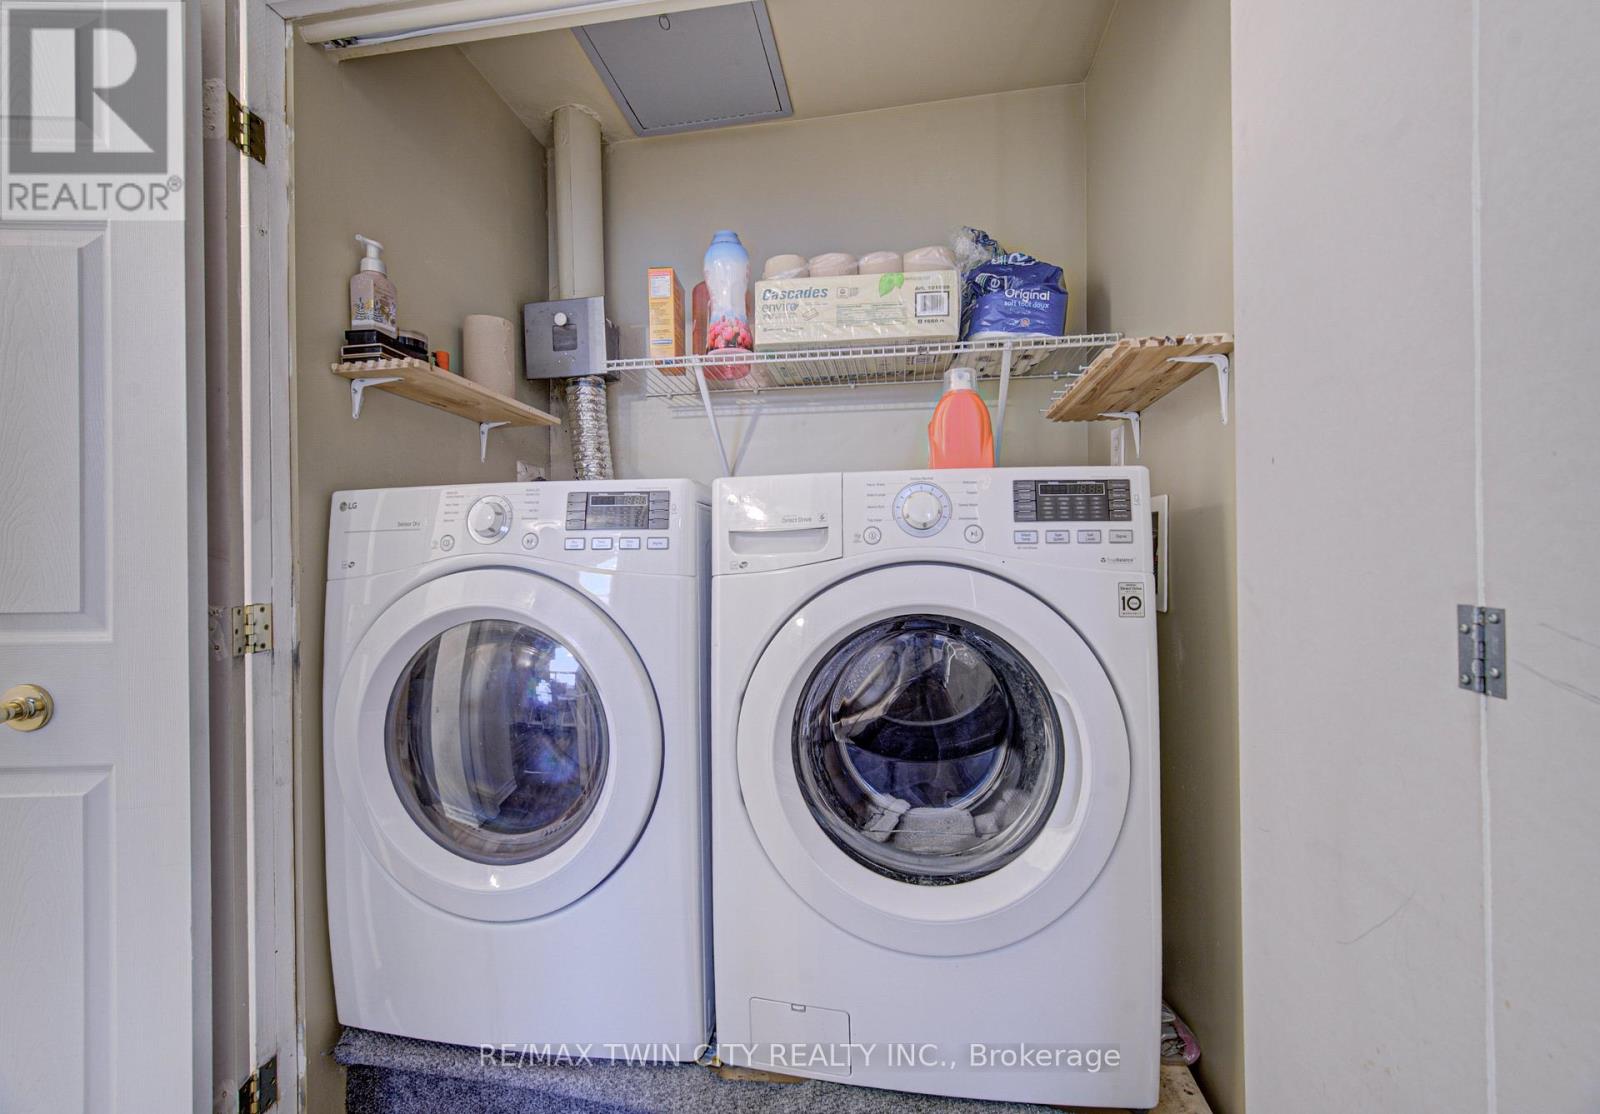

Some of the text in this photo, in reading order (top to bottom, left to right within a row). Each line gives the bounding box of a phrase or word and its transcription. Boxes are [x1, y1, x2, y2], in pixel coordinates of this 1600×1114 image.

[762, 286, 829, 301] Cascades
[1004, 288, 1051, 303] Original
[1121, 595, 1142, 611] 10
